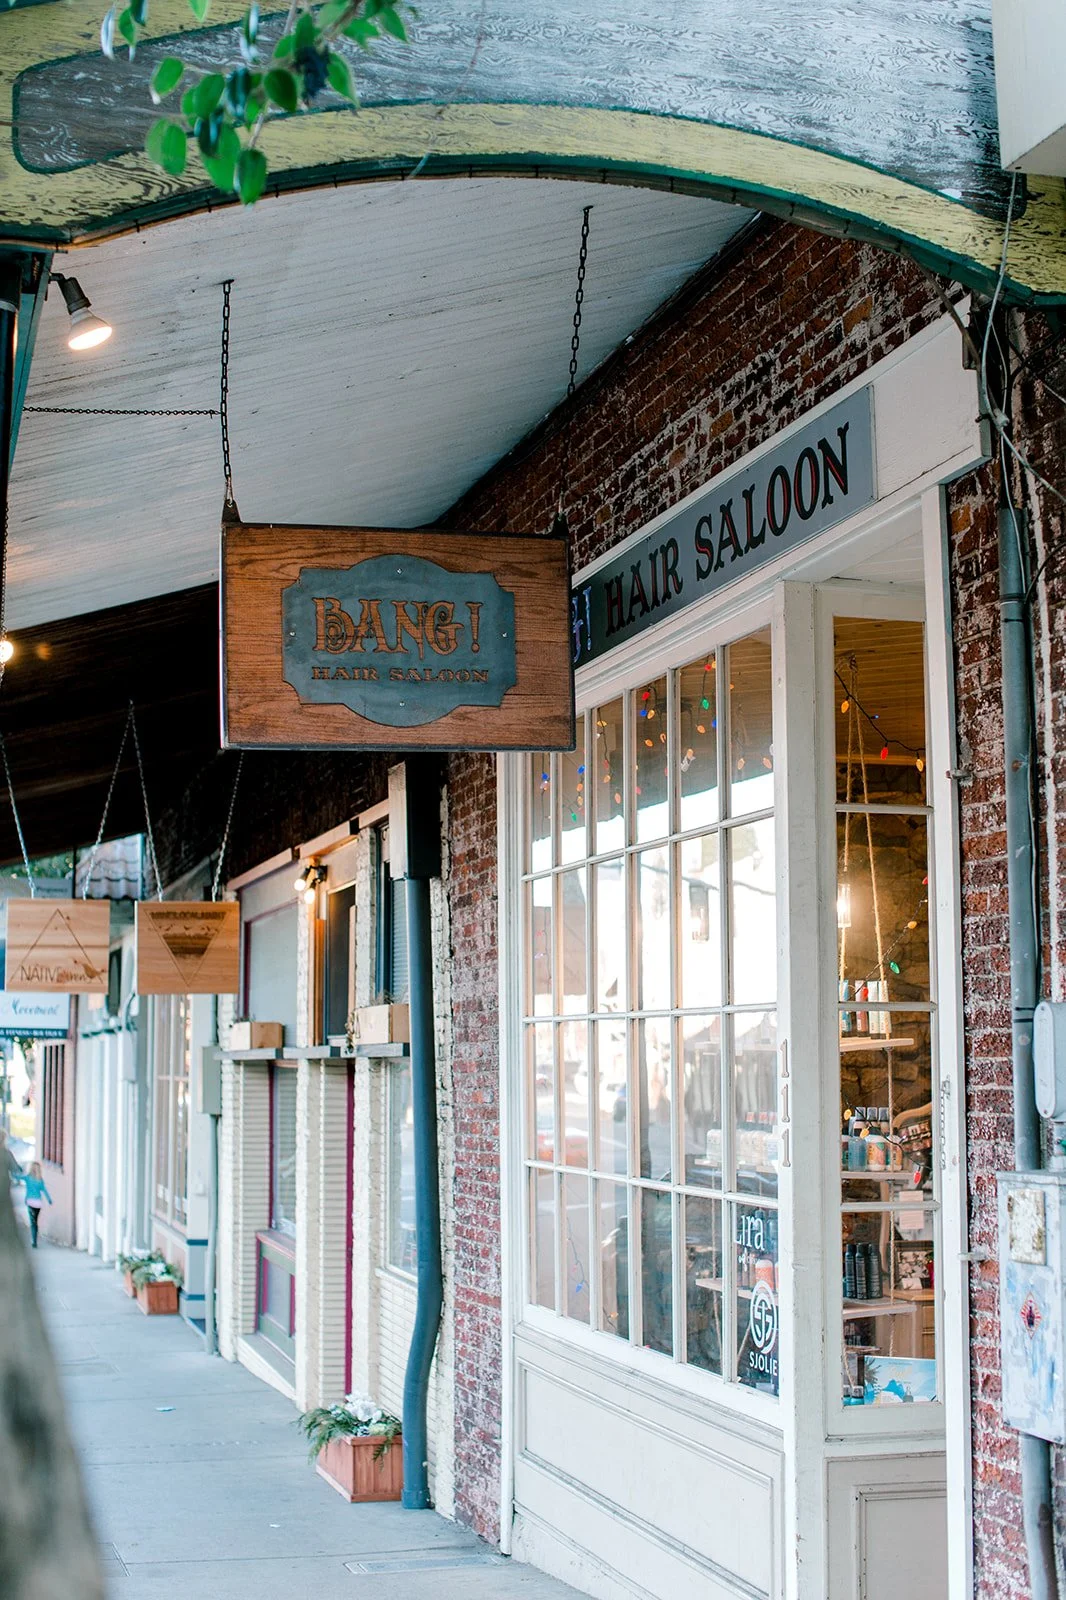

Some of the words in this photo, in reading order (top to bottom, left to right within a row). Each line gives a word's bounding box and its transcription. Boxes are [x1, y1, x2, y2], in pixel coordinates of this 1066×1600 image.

[605, 537, 684, 637] HAIR
[694, 421, 850, 582] SALOON
[311, 597, 484, 660] BANG!
[311, 666, 379, 682] HAIR
[389, 667, 489, 684] SALOON
[749, 1351, 778, 1377] SJOLIE
